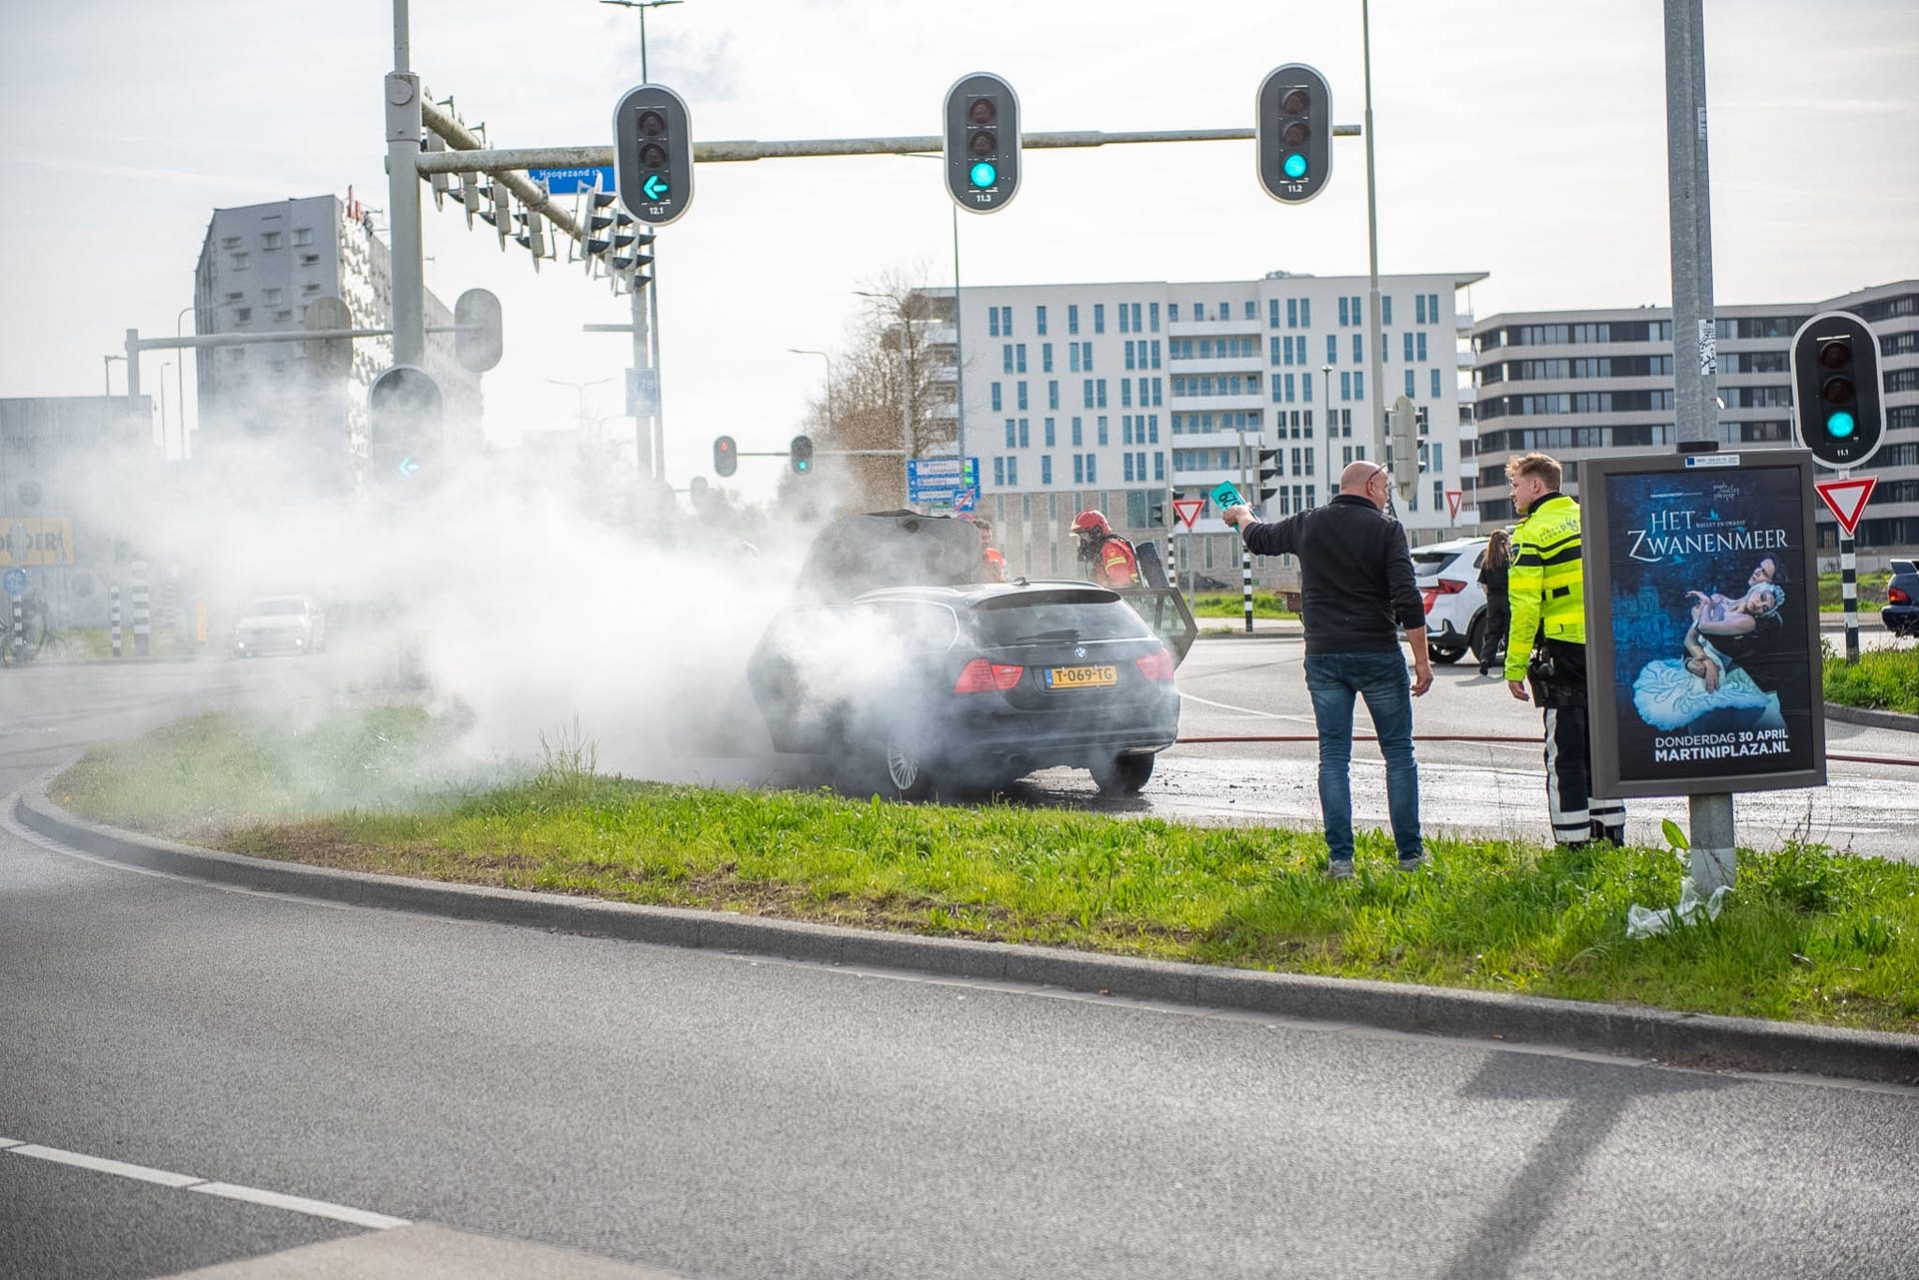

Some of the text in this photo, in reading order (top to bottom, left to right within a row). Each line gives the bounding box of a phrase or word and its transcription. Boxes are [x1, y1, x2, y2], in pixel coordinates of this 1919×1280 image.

[539, 169, 590, 180] Hoogezand
[1287, 185, 1303, 193] 11.2
[976, 194, 992, 203] 11.3
[649, 206, 664, 215] 12.1
[1836, 449, 1849, 457] 11.1
[1650, 509, 1696, 536] HET
[1627, 529, 1789, 562] ZWANENMEER
[1055, 667, 1113, 682] T-069-TG
[1655, 728, 1789, 748] DONDERDAG 30 APRIL
[1655, 740, 1791, 762] MARTINIPLAZA.NL
